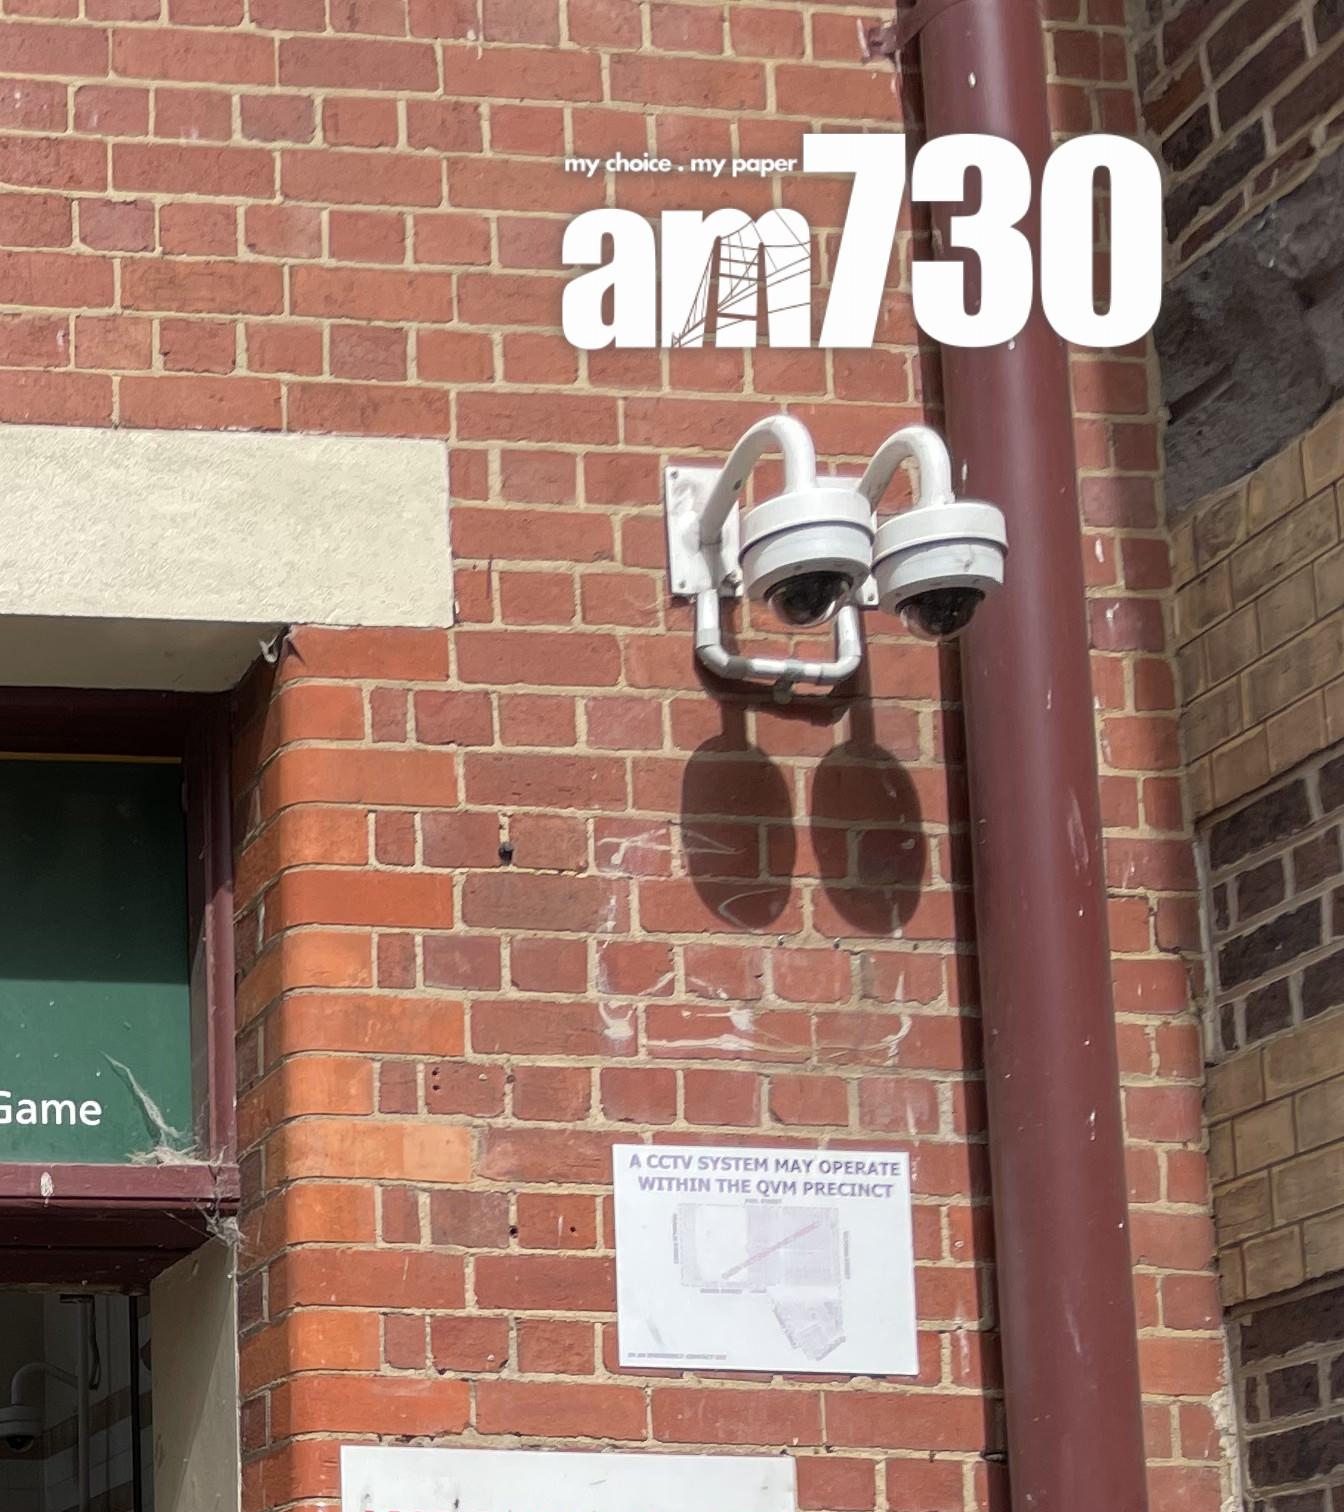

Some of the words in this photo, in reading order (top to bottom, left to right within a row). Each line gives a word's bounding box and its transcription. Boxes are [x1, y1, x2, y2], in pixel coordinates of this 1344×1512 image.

[629, 1154, 642, 1168] A
[646, 1154, 692, 1170] CCTV
[698, 1156, 769, 1173] SYSTEM
[775, 1159, 812, 1175] MAY
[818, 1160, 901, 1176] OPERATE
[638, 1176, 711, 1192] WITHIN
[716, 1178, 751, 1194] THE
[756, 1179, 797, 1196] QVM
[803, 1182, 894, 1198] PRECINCT
